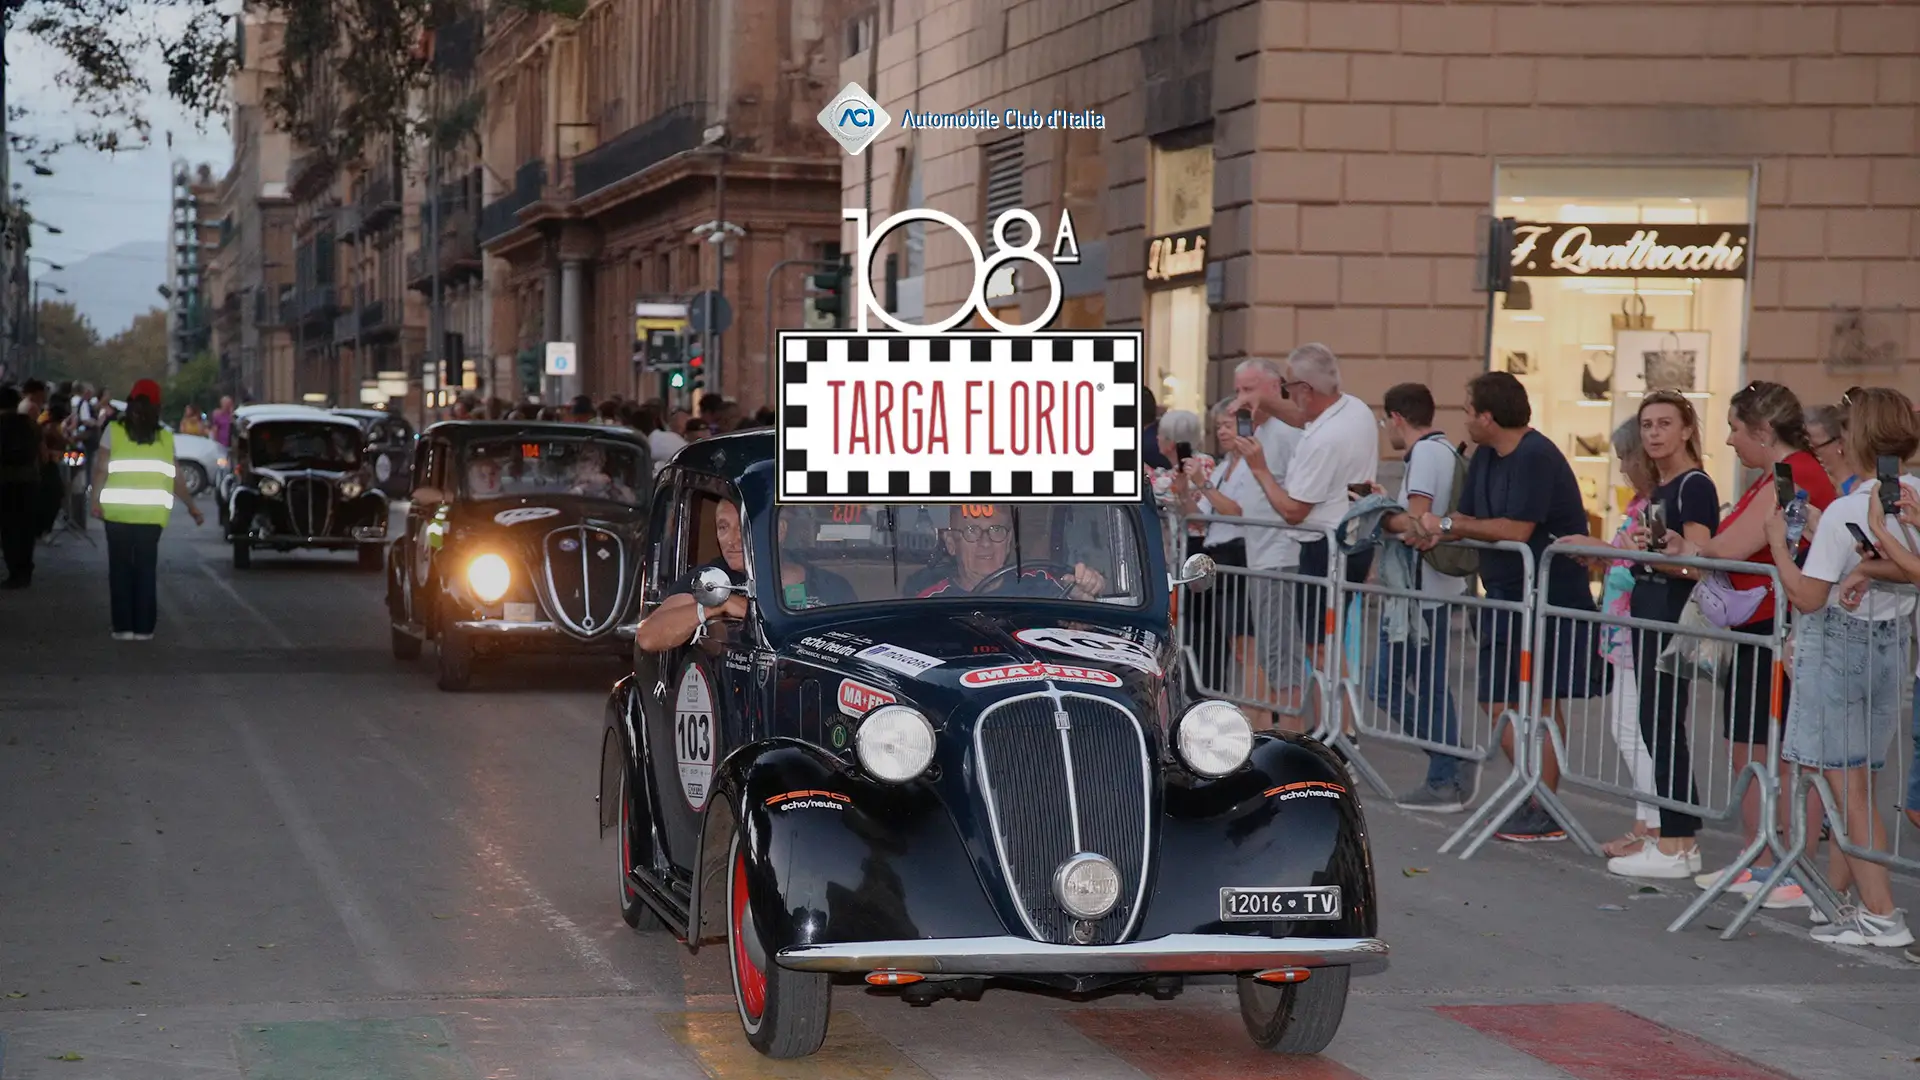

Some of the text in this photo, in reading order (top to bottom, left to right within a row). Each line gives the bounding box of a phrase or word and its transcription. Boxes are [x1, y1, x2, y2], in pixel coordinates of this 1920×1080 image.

[1551, 225, 1748, 275] Quattrocchi
[677, 713, 711, 762] 103
[765, 789, 851, 806] ZERO
[1263, 780, 1347, 798] ZERO
[1279, 788, 1340, 801] echo/neutra
[780, 799, 843, 811] echo/neutra
[1228, 894, 1282, 913] 12016
